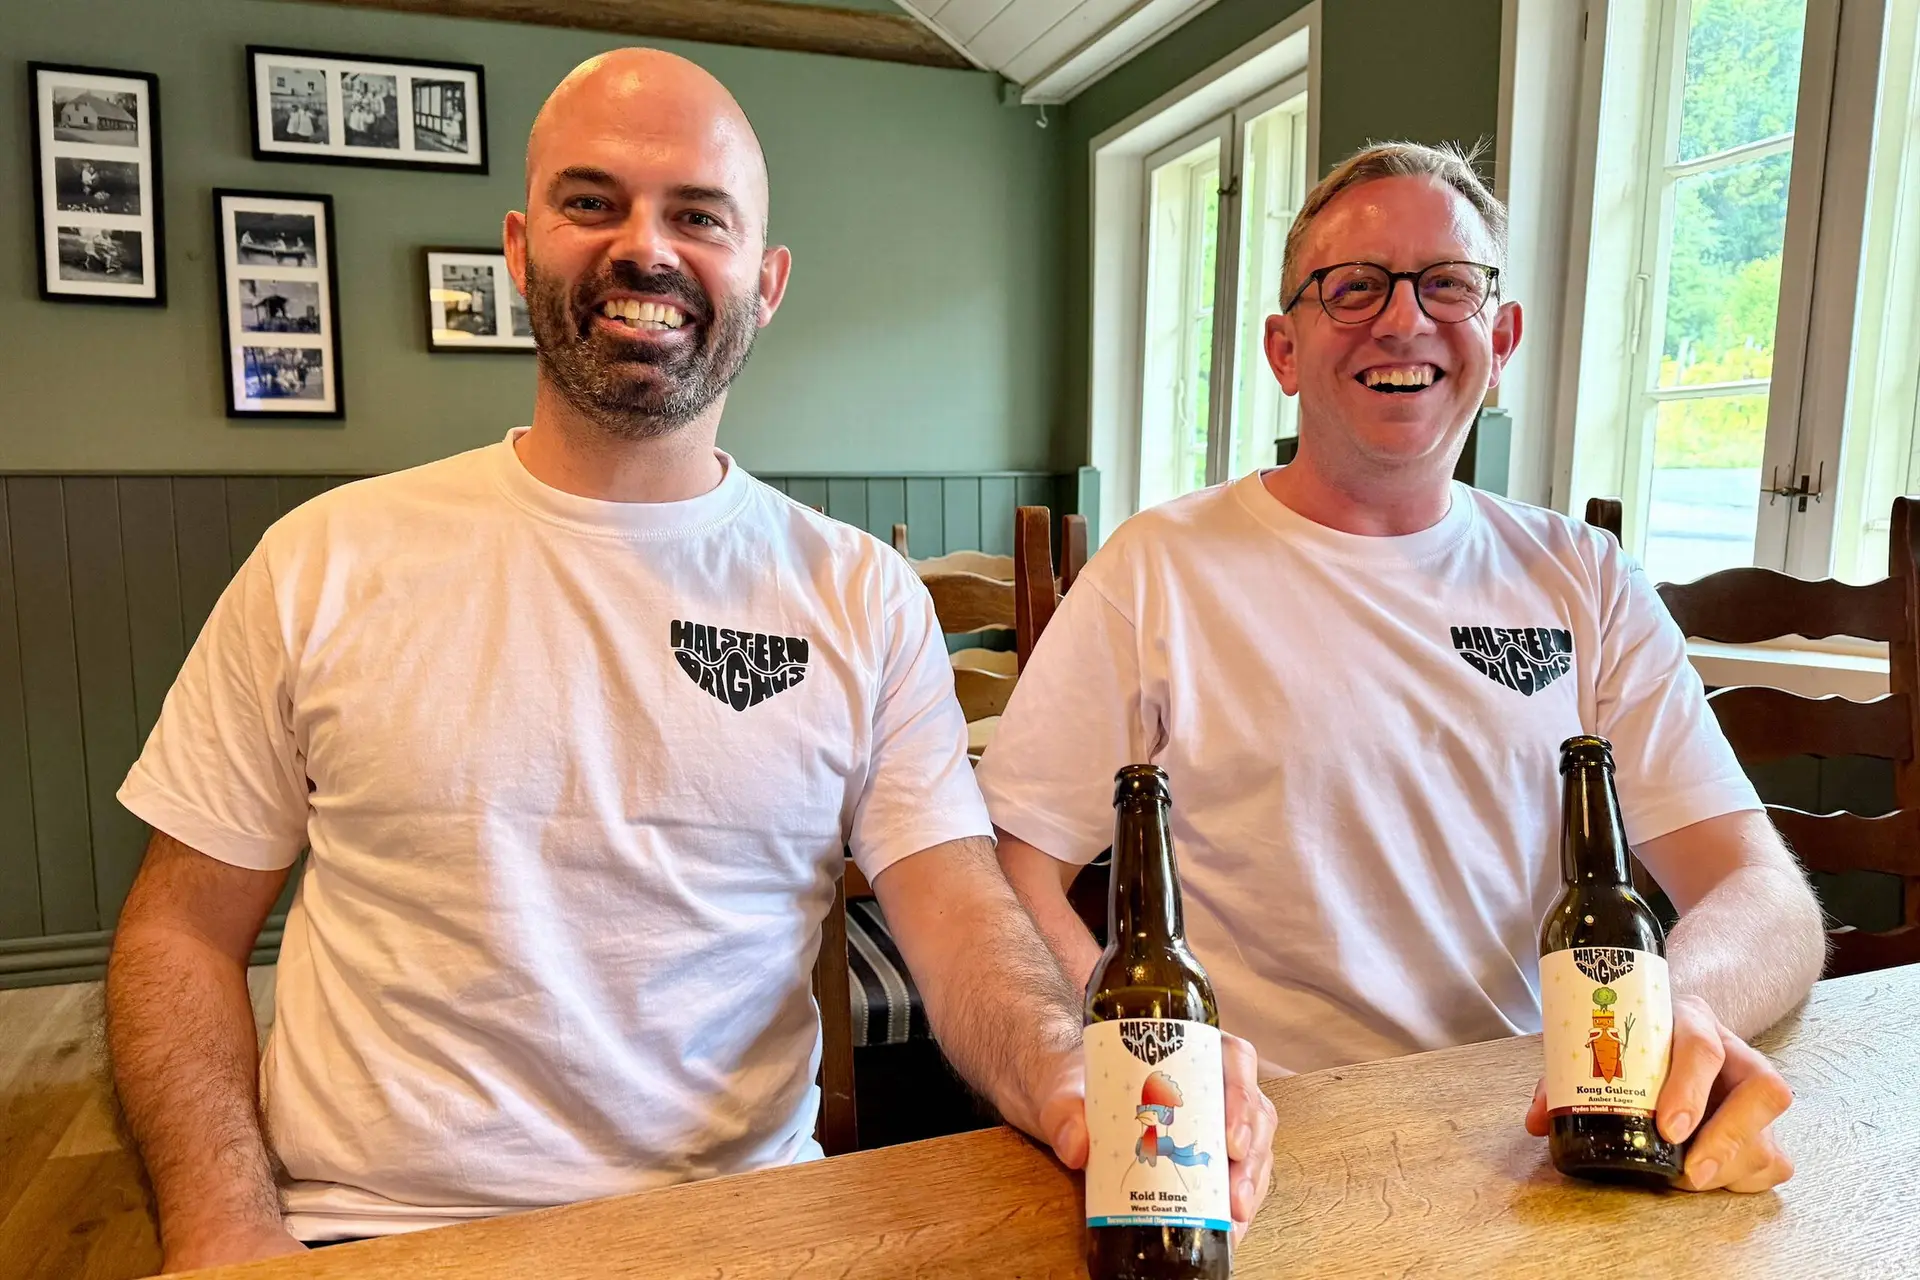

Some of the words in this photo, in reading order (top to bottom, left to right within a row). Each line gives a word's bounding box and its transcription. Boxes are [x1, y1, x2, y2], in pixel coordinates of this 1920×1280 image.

[674, 651, 806, 712] BRYGHUS
[1459, 647, 1571, 697] BRYGHUS
[1575, 958, 1634, 985] BRYGHUS
[1122, 1033, 1184, 1066] BRYGHUS
[1576, 1086, 1602, 1096] Kong
[1605, 1086, 1646, 1097] Gulerod
[1614, 1097, 1633, 1105] Lager
[1130, 1191, 1155, 1201] Kold
[1159, 1191, 1188, 1202] Høne
[1151, 1205, 1172, 1213] Coast
